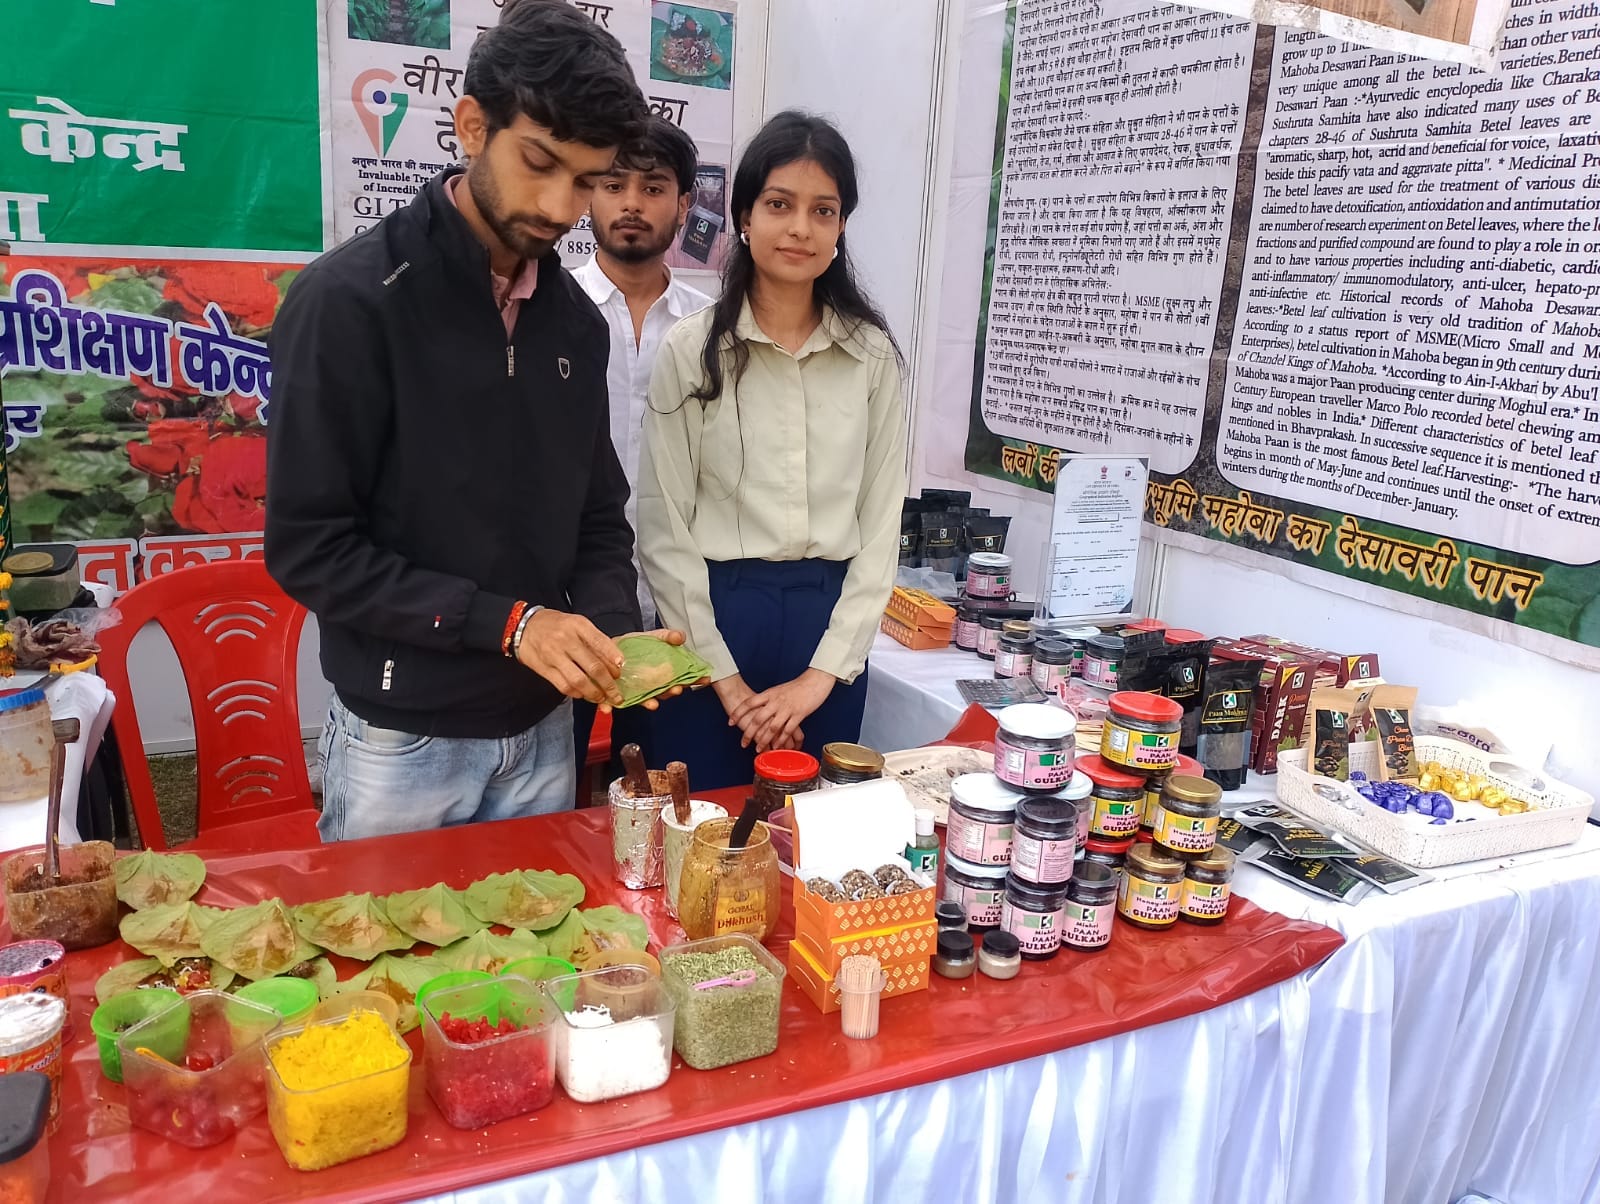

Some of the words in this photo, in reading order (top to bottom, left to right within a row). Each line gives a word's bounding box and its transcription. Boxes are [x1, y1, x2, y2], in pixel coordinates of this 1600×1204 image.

[1236, 22, 1250, 33] तक
[1280, 65, 1319, 78] Mahoba
[1321, 55, 1367, 73] Desawari
[1369, 54, 1394, 67] Paan
[1397, 53, 1405, 63] is
[1282, 48, 1308, 64] grow
[1311, 46, 1322, 60] up
[1327, 45, 1336, 54] to
[403, 55, 463, 98] वीर
[1279, 84, 1298, 97] very
[1303, 79, 1337, 95] unique
[1344, 75, 1380, 90] among
[1386, 70, 1400, 83] all
[1406, 67, 1425, 82] the
[1433, 63, 1461, 79] betel
[1275, 97, 1318, 112] Desawari
[1324, 96, 1347, 108] Paan
[1427, 78, 1503, 100] encyclopedia
[1510, 75, 1534, 90] like
[1543, 67, 1600, 86] Charaka
[1272, 117, 1313, 130] Sushruta
[1319, 113, 1361, 126] Samhita
[1367, 110, 1390, 122] have
[1396, 107, 1418, 120] also
[1424, 100, 1478, 118] indicated
[1483, 99, 1520, 114] many
[1526, 96, 1555, 108] uses
[1563, 90, 1581, 105] of
[8, 96, 187, 172] केन्द्र
[1161, 128, 1185, 140] 28-46
[1194, 124, 1208, 136] पान
[1211, 122, 1218, 134] के
[1269, 135, 1309, 148] chapters
[1315, 131, 1345, 144] 28-46
[1352, 129, 1365, 141] of
[1369, 127, 1418, 141] Sushruta
[1426, 122, 1471, 137] Samhita
[1480, 118, 1512, 133] Betel
[1520, 115, 1559, 130] leaves
[1569, 114, 1591, 126] are
[352, 157, 378, 168] अतुल्य
[381, 159, 402, 168] भारत
[405, 159, 416, 170] की
[420, 162, 444, 174] अमूल्य
[358, 169, 410, 182] Invaluable
[413, 174, 432, 183] Tre
[364, 183, 374, 191] of
[354, 196, 382, 216] GI
[1261, 203, 1296, 215] claimed
[1300, 203, 1308, 213] to
[1311, 201, 1333, 213] have
[1335, 200, 1405, 213] detoxification,
[1408, 198, 1484, 212] antioxidation
[1486, 198, 1512, 211] and
[1254, 254, 1271, 265] and
[1276, 255, 1286, 265] to
[1289, 253, 1310, 266] have
[1315, 255, 1349, 267] various
[1352, 255, 1403, 270] properties
[1408, 255, 1465, 273] including
[1470, 257, 1556, 275] anti-diabetic,
[1251, 270, 1340, 287] anti-inflammatory/
[1343, 273, 1454, 291] immunomodulatory,
[1463, 277, 1526, 294] anti-ulcer,
[1249, 287, 1308, 299] anti-infective
[1316, 289, 1332, 300] etc.
[1340, 290, 1391, 304] Historical
[1401, 294, 1443, 307] records
[1455, 295, 1470, 308] of
[1479, 297, 1533, 312] Mahoba
[1238, 352, 1249, 362] of
[1249, 352, 1285, 366] Chandel
[1287, 356, 1314, 371] Kings
[1317, 360, 1328, 370] of
[1330, 360, 1377, 376] Mahoba.
[1450, 373, 1461, 385] to
[1464, 374, 1539, 393] Ain-I-Akbari
[1542, 382, 1558, 399] by
[1561, 385, 1599, 401] Abu'l
[1233, 382, 1268, 399] Century
[1270, 387, 1315, 403] European
[1320, 393, 1363, 409] traveller
[1366, 398, 1401, 413] Marco
[1403, 402, 1428, 417] Polo
[1432, 409, 1483, 425] recorded
[1486, 415, 1516, 431] betel
[1518, 420, 1575, 443] chewing
[1222, 461, 1257, 475] winters
[1259, 465, 1289, 483] during
[1290, 471, 1305, 484] the
[1306, 476, 1343, 493] months
[1344, 483, 1358, 494] of
[1412, 497, 1459, 520] January.
[1002, 444, 1037, 479] लबों
[1202, 491, 1284, 543] महोबा
[1288, 513, 1332, 555] का
[1337, 516, 1460, 589] देसावरी
[1467, 557, 1544, 611] पान
[1272, 695, 1288, 740] DARK
[1061, 929, 1108, 942] GULKAND
[1073, 927, 1099, 936] PAAN
